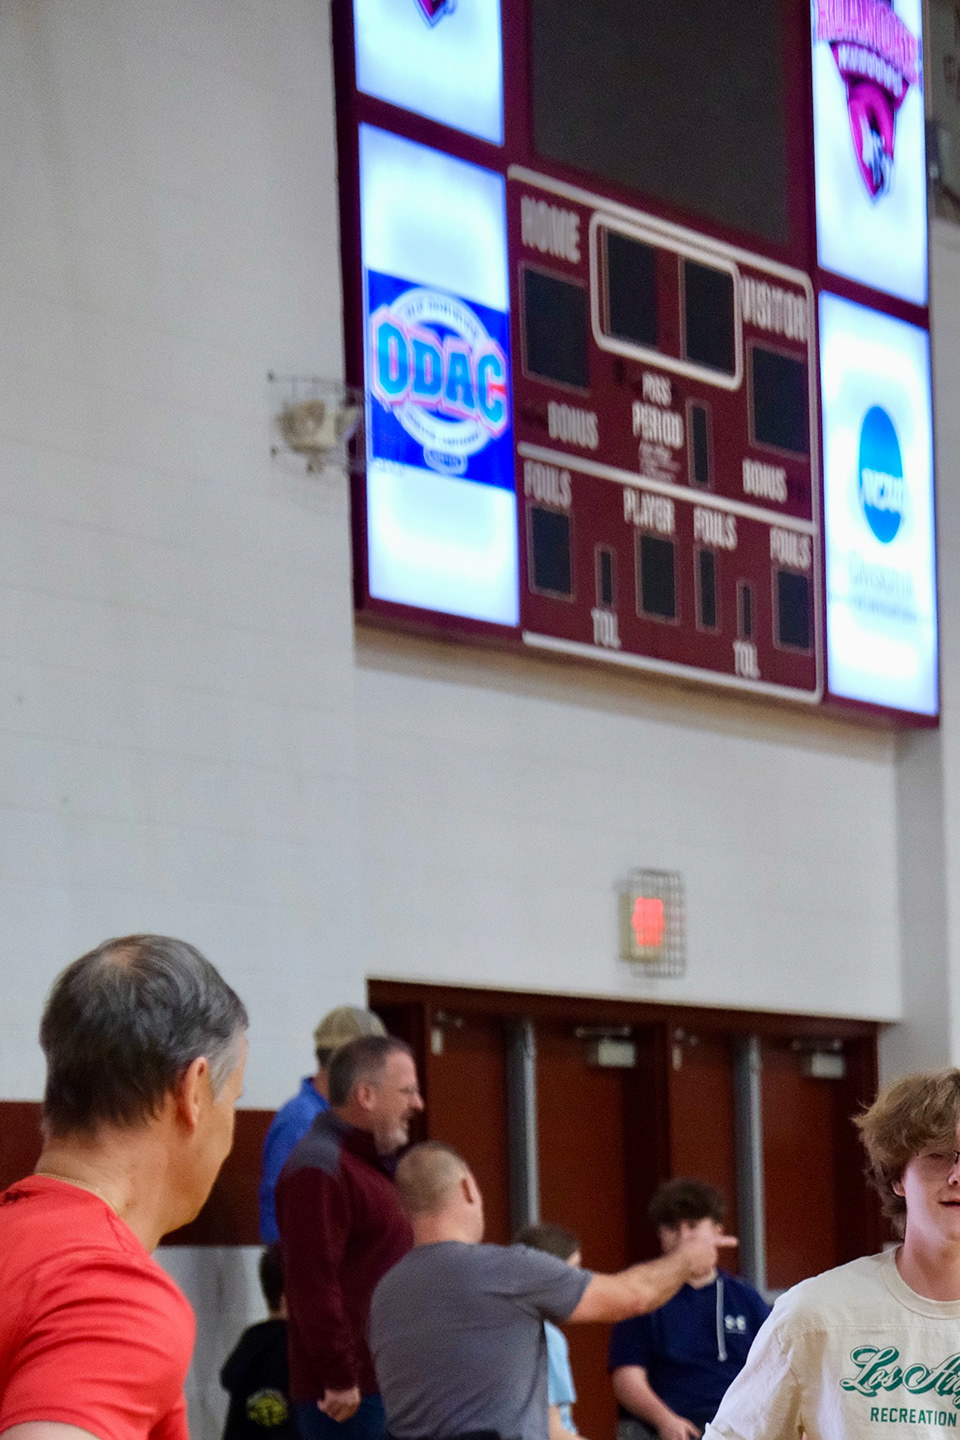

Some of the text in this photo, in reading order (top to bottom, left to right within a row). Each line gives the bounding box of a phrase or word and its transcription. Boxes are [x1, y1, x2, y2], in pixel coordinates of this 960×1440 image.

[521, 195, 581, 264] HOME
[741, 276, 809, 343] VISITOR
[376, 318, 507, 428] ODAC
[548, 401, 599, 450] BONUS
[632, 401, 684, 449] PERIOD
[524, 460, 572, 510] FOULS
[743, 458, 788, 504] BONUS
[624, 488, 675, 535] PLAYER
[694, 507, 738, 551] FOULS
[771, 528, 812, 570] FOULS
[840, 1345, 902, 1397] Los
[870, 1407, 957, 1428] RECREATION
